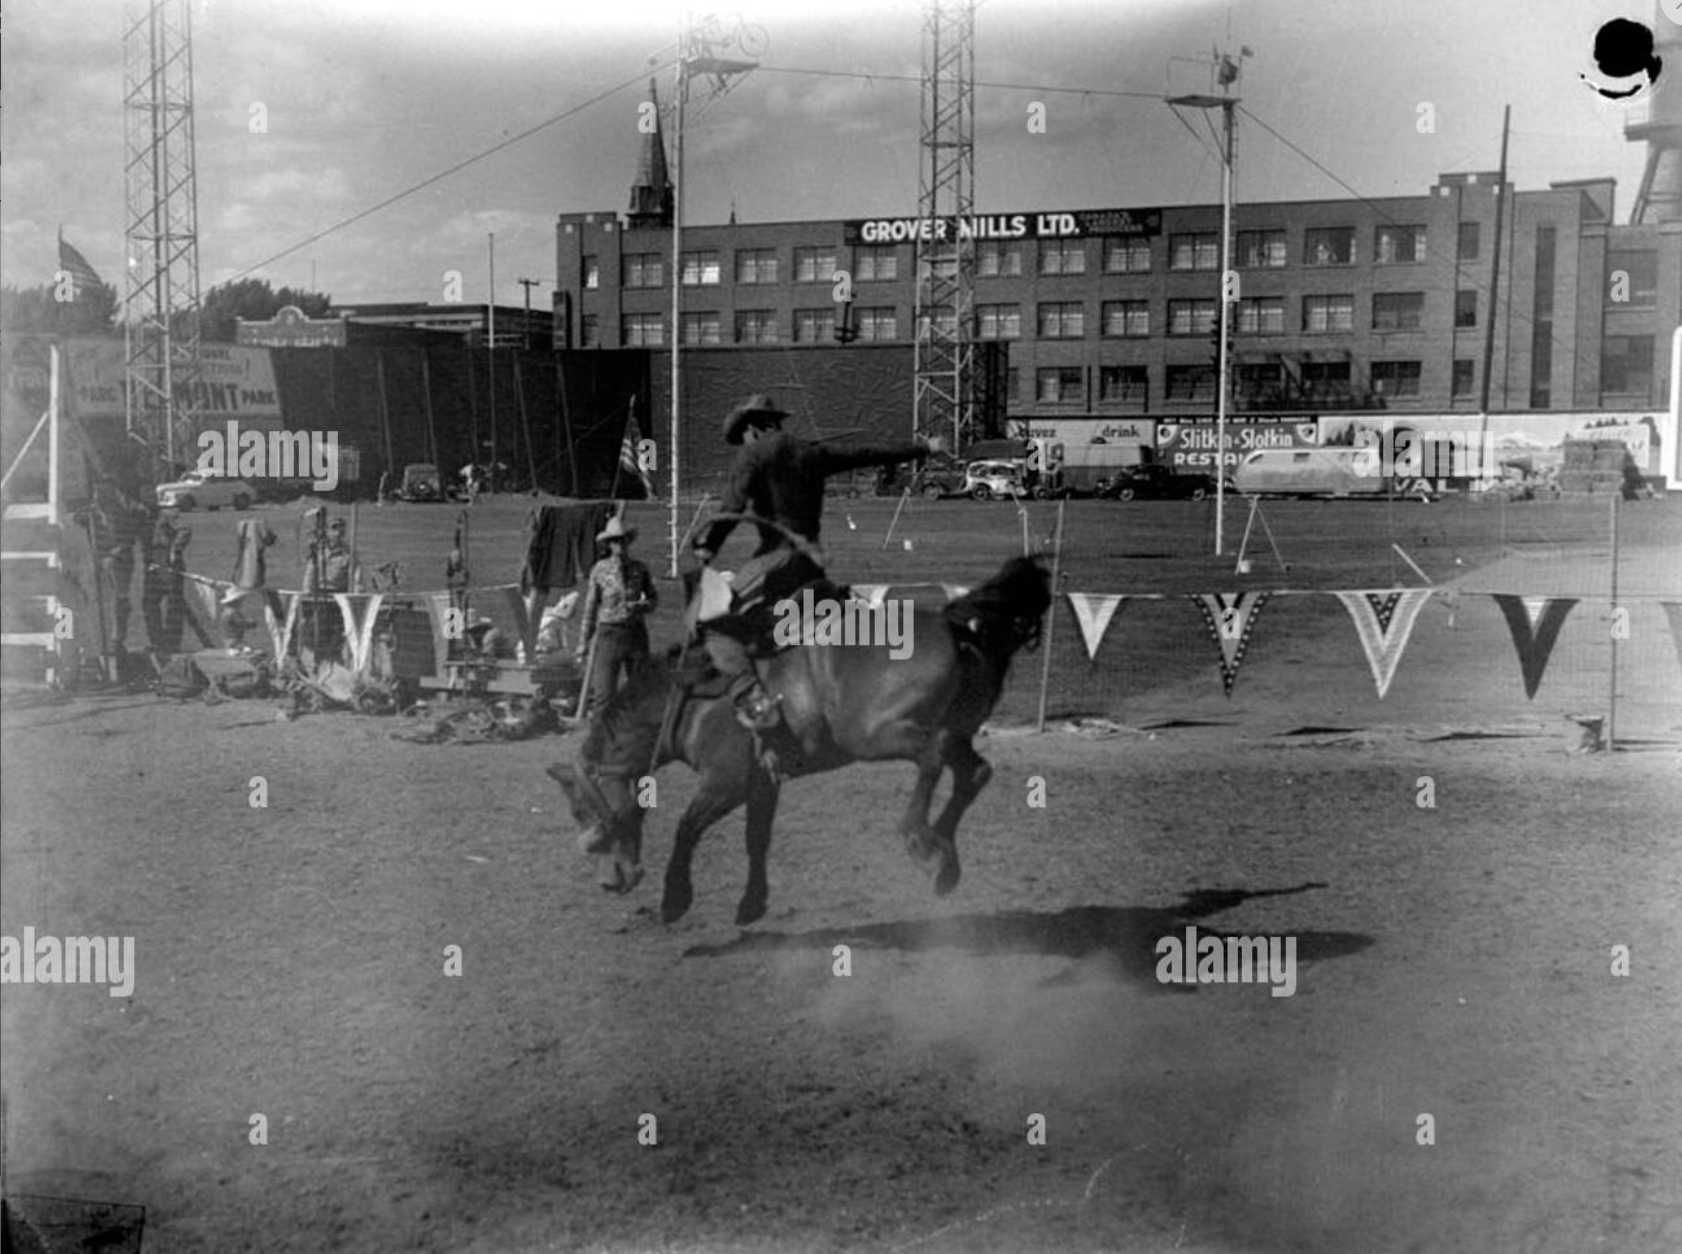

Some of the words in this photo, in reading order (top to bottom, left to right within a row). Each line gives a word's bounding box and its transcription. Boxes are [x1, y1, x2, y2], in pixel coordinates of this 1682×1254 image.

[861, 218, 947, 242] GROVER
[959, 215, 1027, 238] MILLS
[1037, 213, 1080, 235] LTD.
[1102, 423, 1140, 438] drink
[1180, 427, 1232, 449] Slitkn
[1240, 427, 1293, 449] Slotkin
